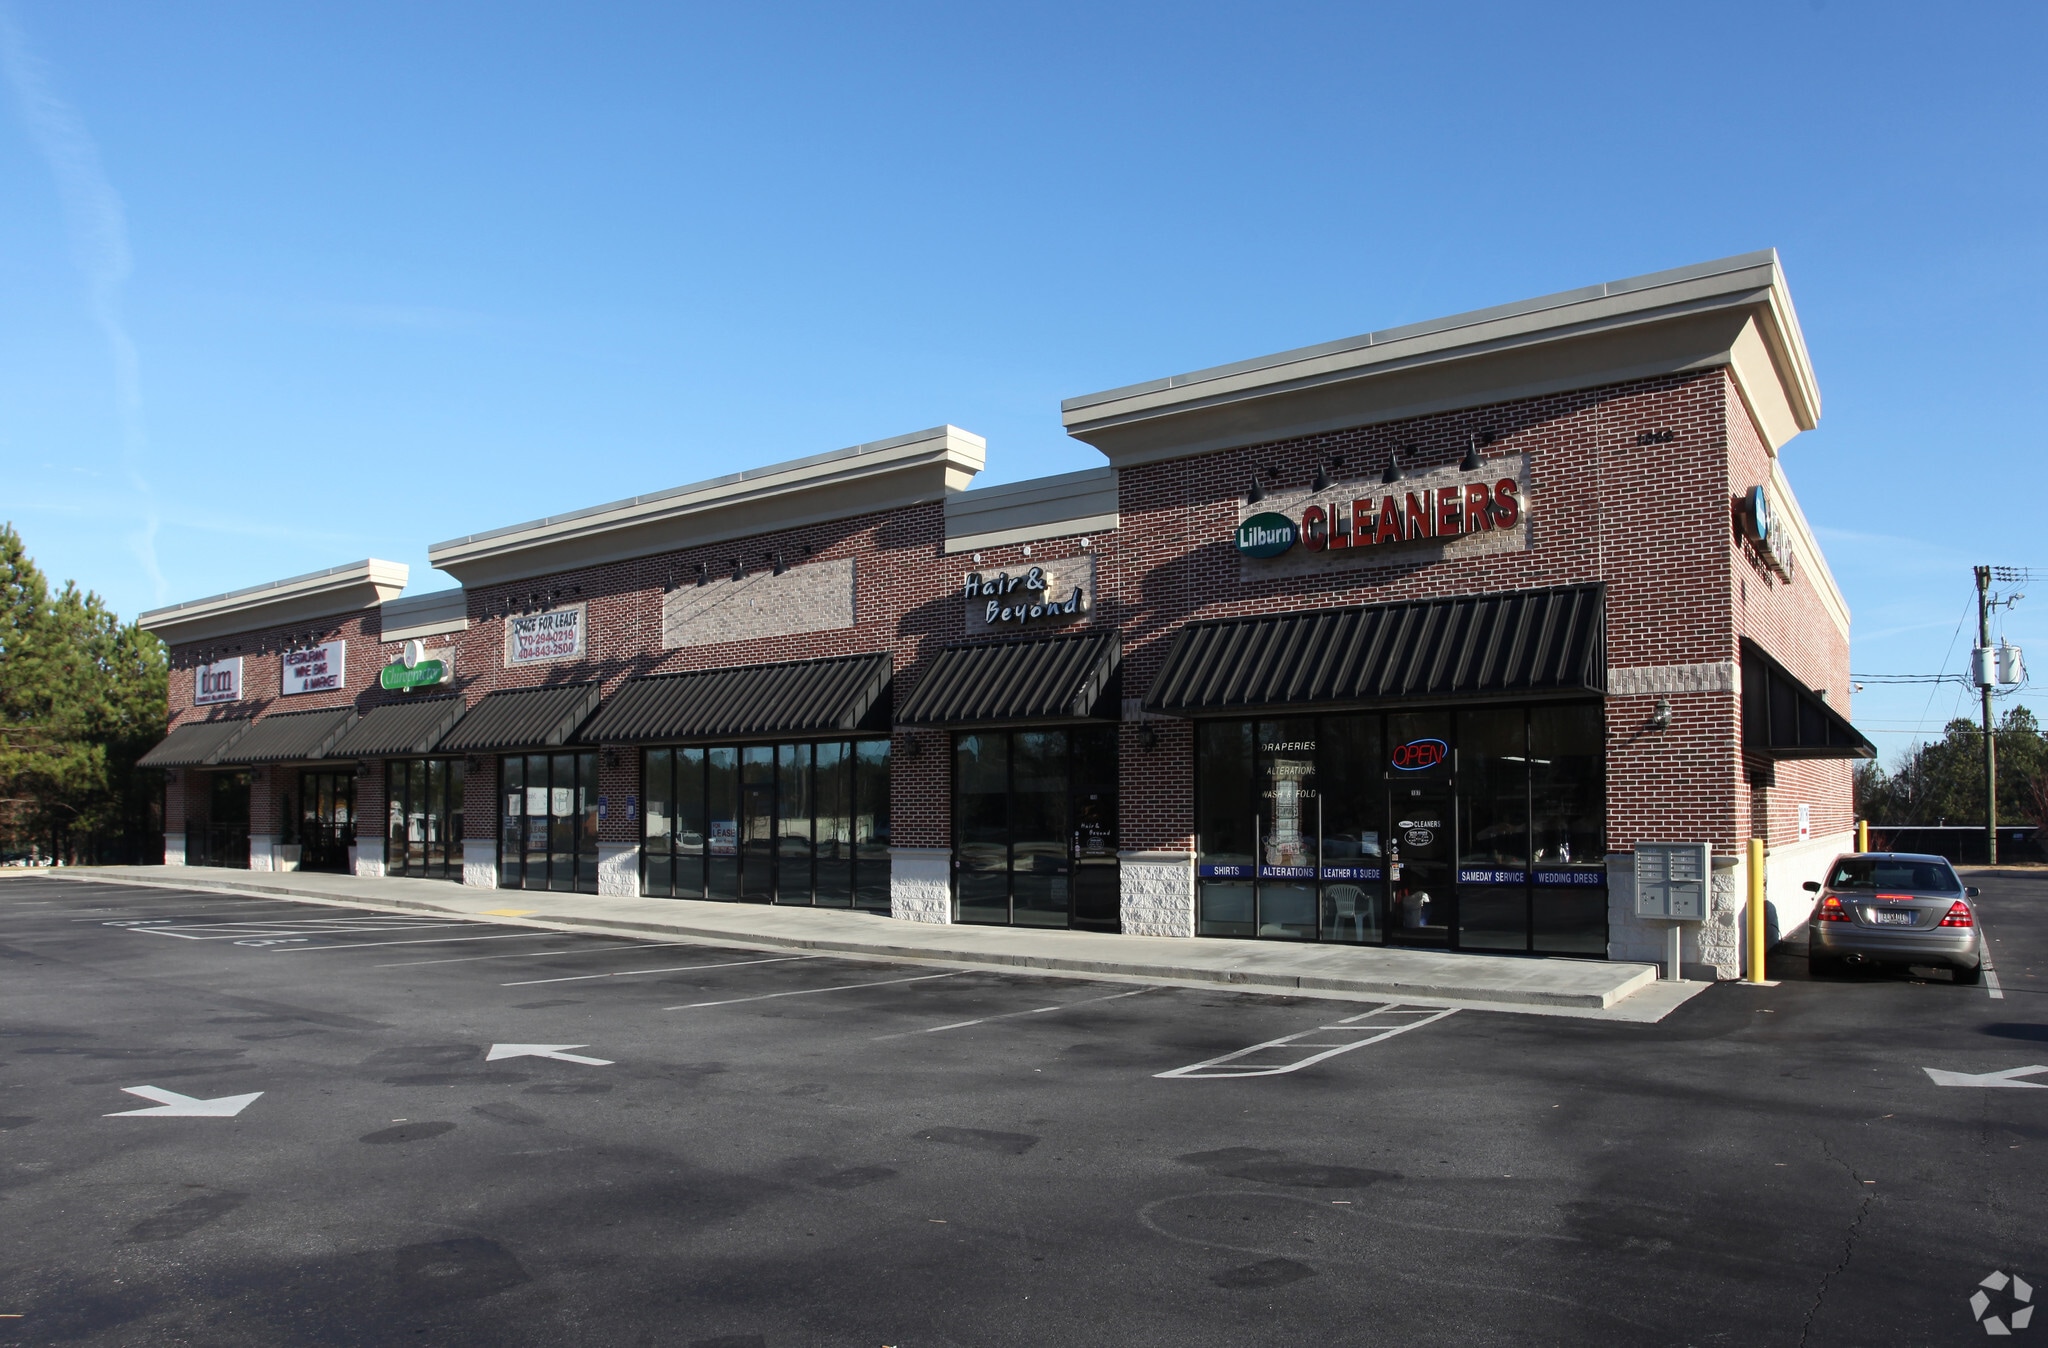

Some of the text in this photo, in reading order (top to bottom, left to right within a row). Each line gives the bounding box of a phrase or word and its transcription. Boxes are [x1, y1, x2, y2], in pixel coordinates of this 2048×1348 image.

[1239, 477, 1521, 553] Lilburn CLEANERS
[964, 567, 1045, 599] Hair &
[985, 587, 1082, 625] Beyond
[514, 611, 579, 635] SPACE FOR LEASE
[285, 648, 328, 666] RESTAURANT
[518, 642, 574, 660] 404-843-2500
[313, 662, 328, 676] BAR
[385, 667, 442, 686] Chiropractor
[1261, 741, 1316, 751] DRAPERIES
[1393, 744, 1444, 765] OPEN
[1266, 766, 1316, 775] ALTERATIONS
[1262, 790, 1283, 798] WASH
[1295, 789, 1317, 798] FOLD
[1413, 820, 1441, 828] CLEANERS
[712, 829, 736, 838] LEASE
[1214, 866, 1240, 876] SHIRTS
[1262, 867, 1314, 877] ALTERATIONS
[1323, 868, 1380, 879] LEATHER & SUEDE
[1461, 871, 1525, 883] SAMEDAY SERVICE
[1538, 872, 1599, 884] WEDDING DRESS
